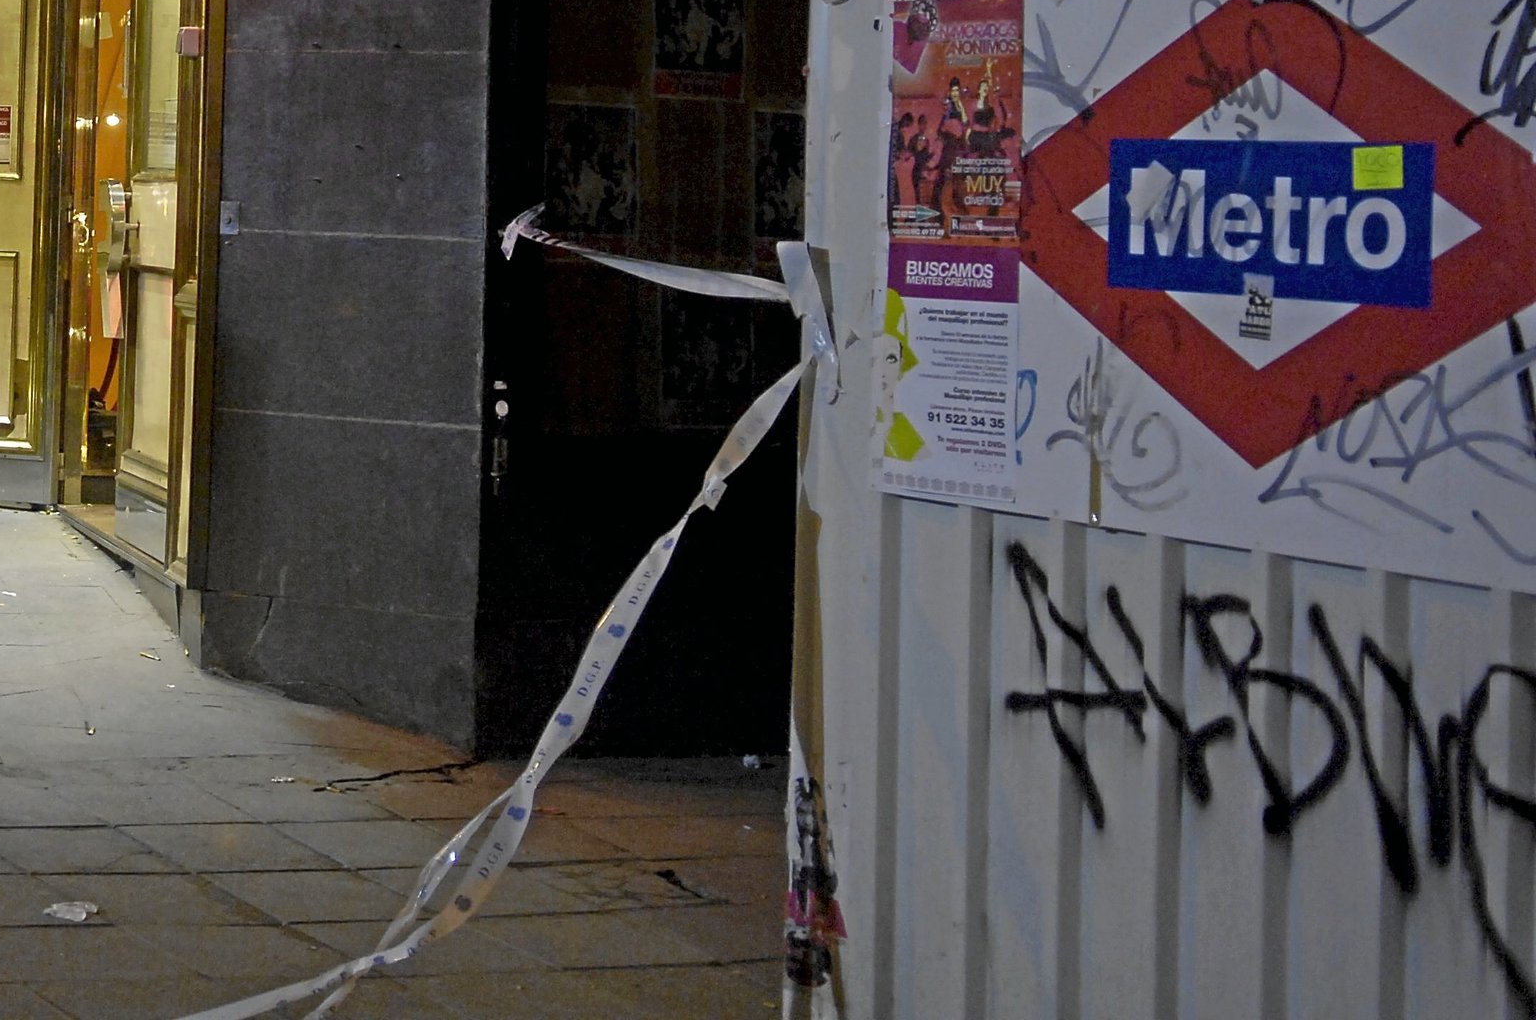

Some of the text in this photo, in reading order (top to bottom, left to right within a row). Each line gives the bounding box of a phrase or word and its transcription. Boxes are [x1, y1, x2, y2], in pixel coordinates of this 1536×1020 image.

[1127, 166, 1408, 271] Metro
[906, 260, 994, 279] BUSCAMOS
[906, 275, 993, 289] MENTES CREATIVAS
[928, 411, 1005, 430] 91 522 34 35
